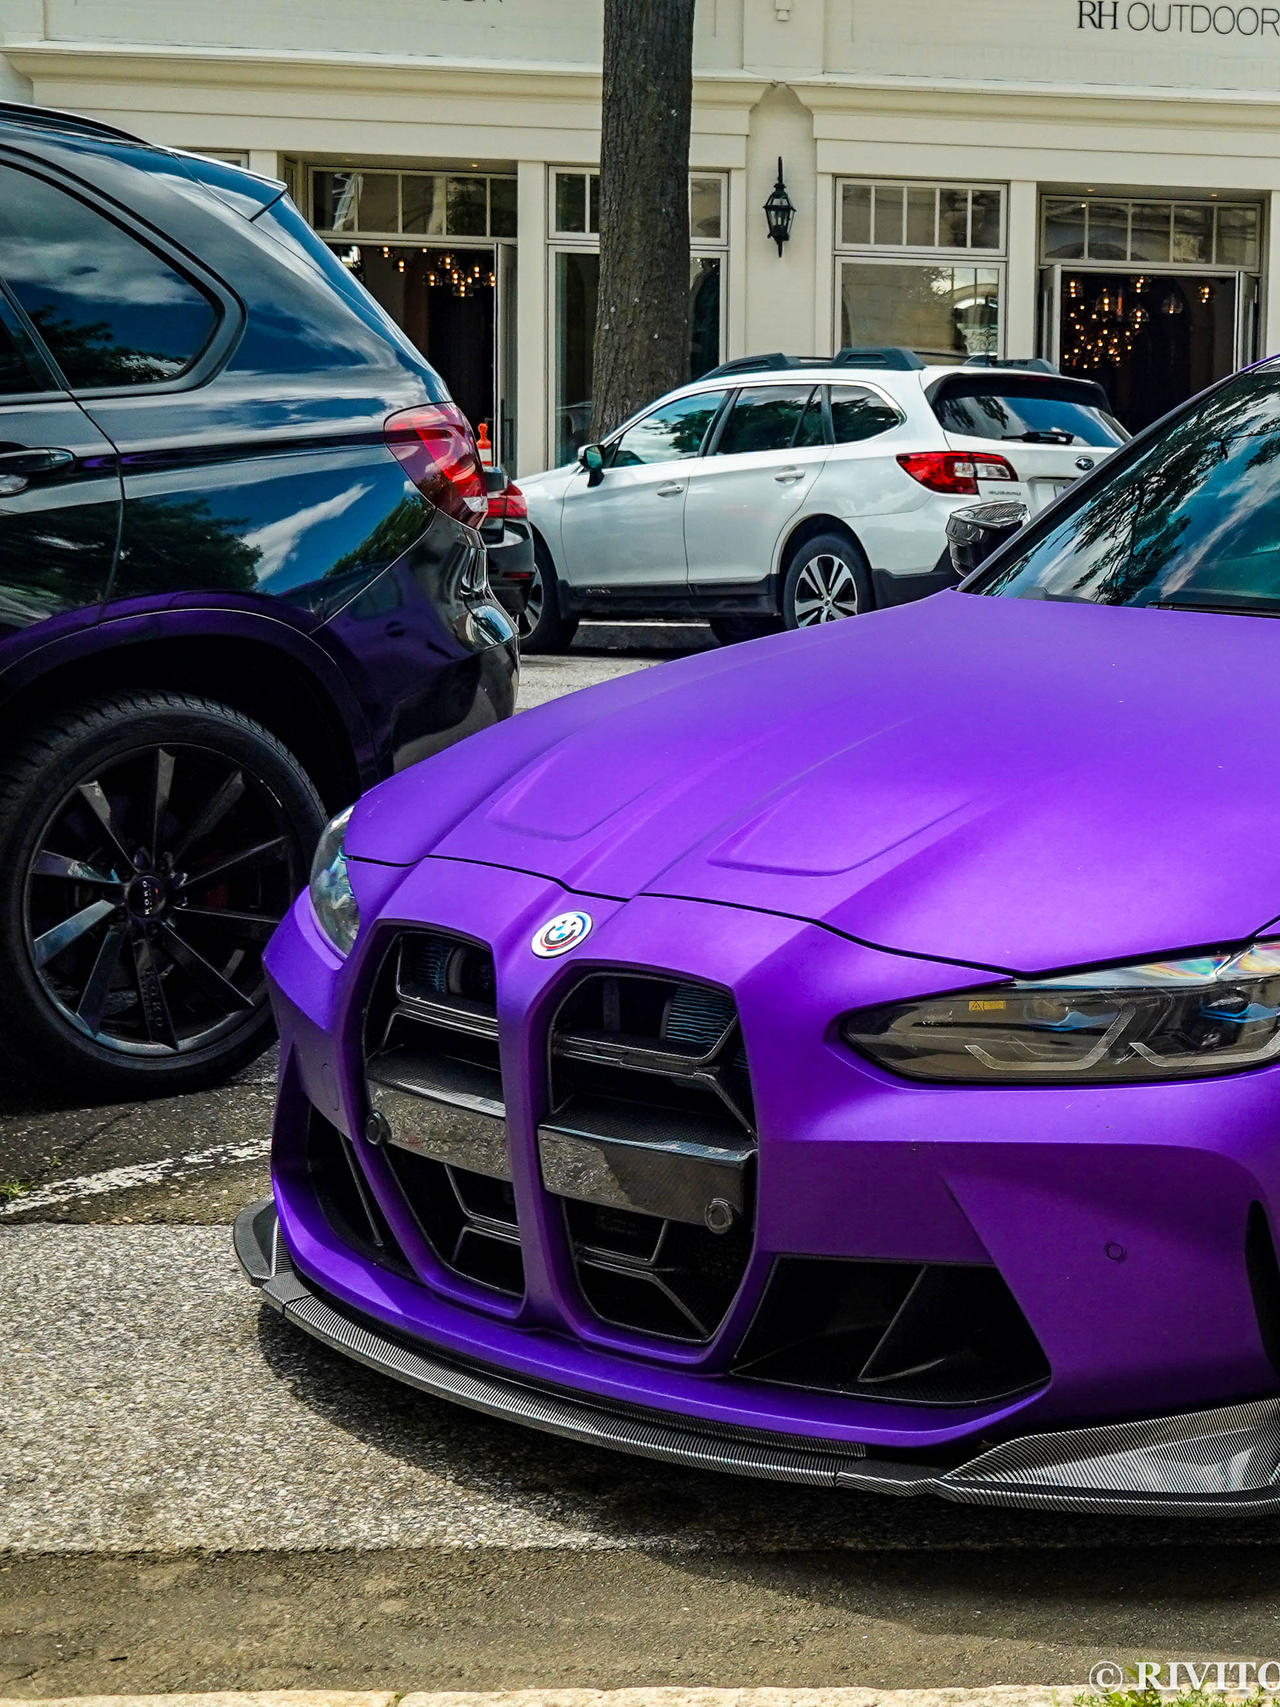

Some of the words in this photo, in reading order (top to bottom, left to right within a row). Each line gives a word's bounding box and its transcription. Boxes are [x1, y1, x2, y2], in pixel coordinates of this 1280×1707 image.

[1077, 0, 1118, 30] RH
[1127, 2, 1280, 37] OUTDOOR
[142, 880, 150, 915] KOKO
